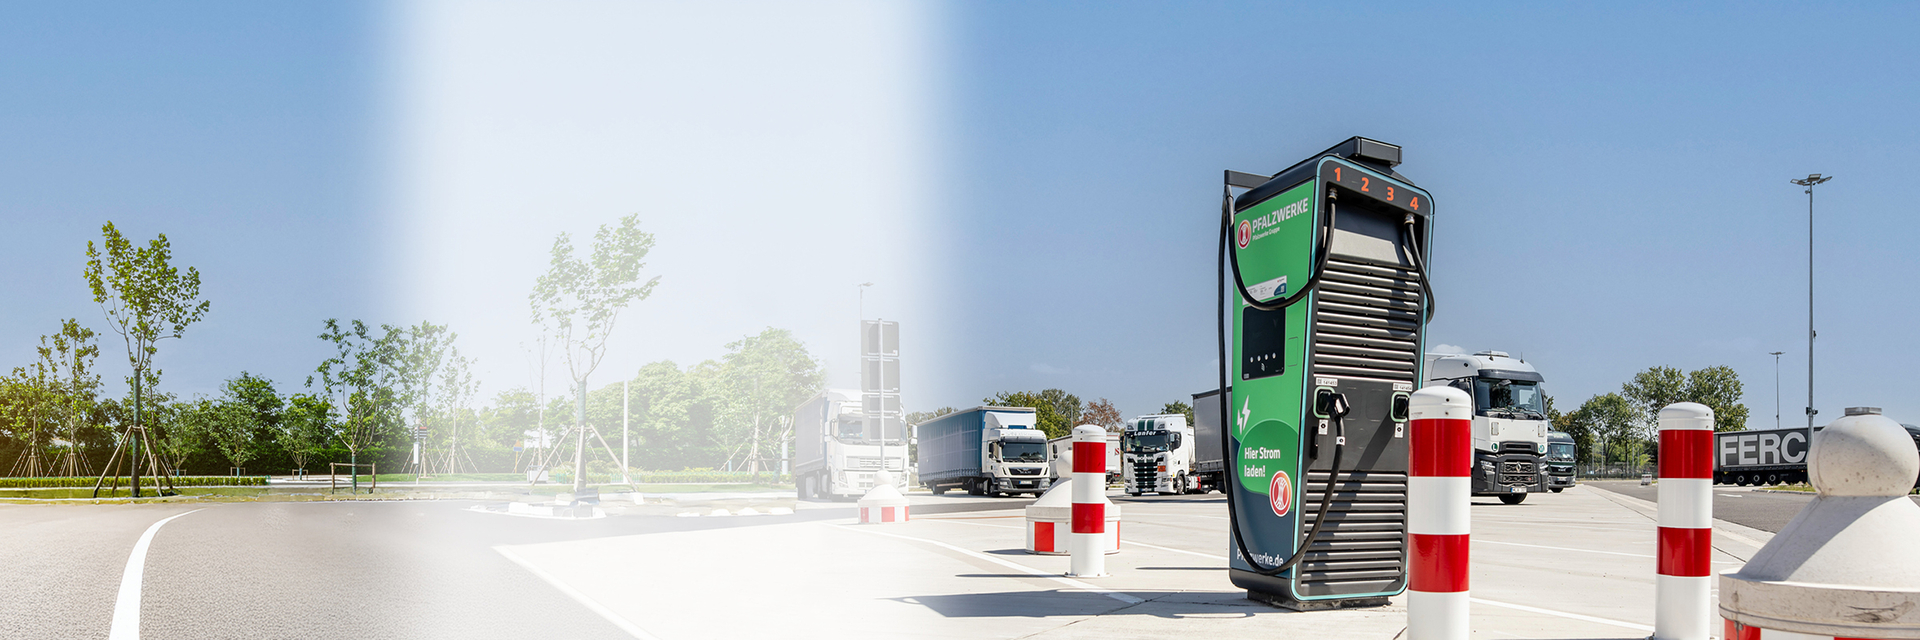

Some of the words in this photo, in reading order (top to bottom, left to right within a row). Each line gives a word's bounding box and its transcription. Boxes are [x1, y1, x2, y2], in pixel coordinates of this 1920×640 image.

[1334, 167, 1341, 182] 1
[1361, 177, 1370, 192] 2
[1386, 187, 1395, 202] 3
[1410, 196, 1419, 211] 4
[1252, 197, 1309, 233] PFALZWERKE
[1244, 446, 1259, 459] Hier
[1259, 446, 1281, 459] Strom
[1720, 432, 1807, 466] FERC
[1244, 464, 1266, 478] laden!
